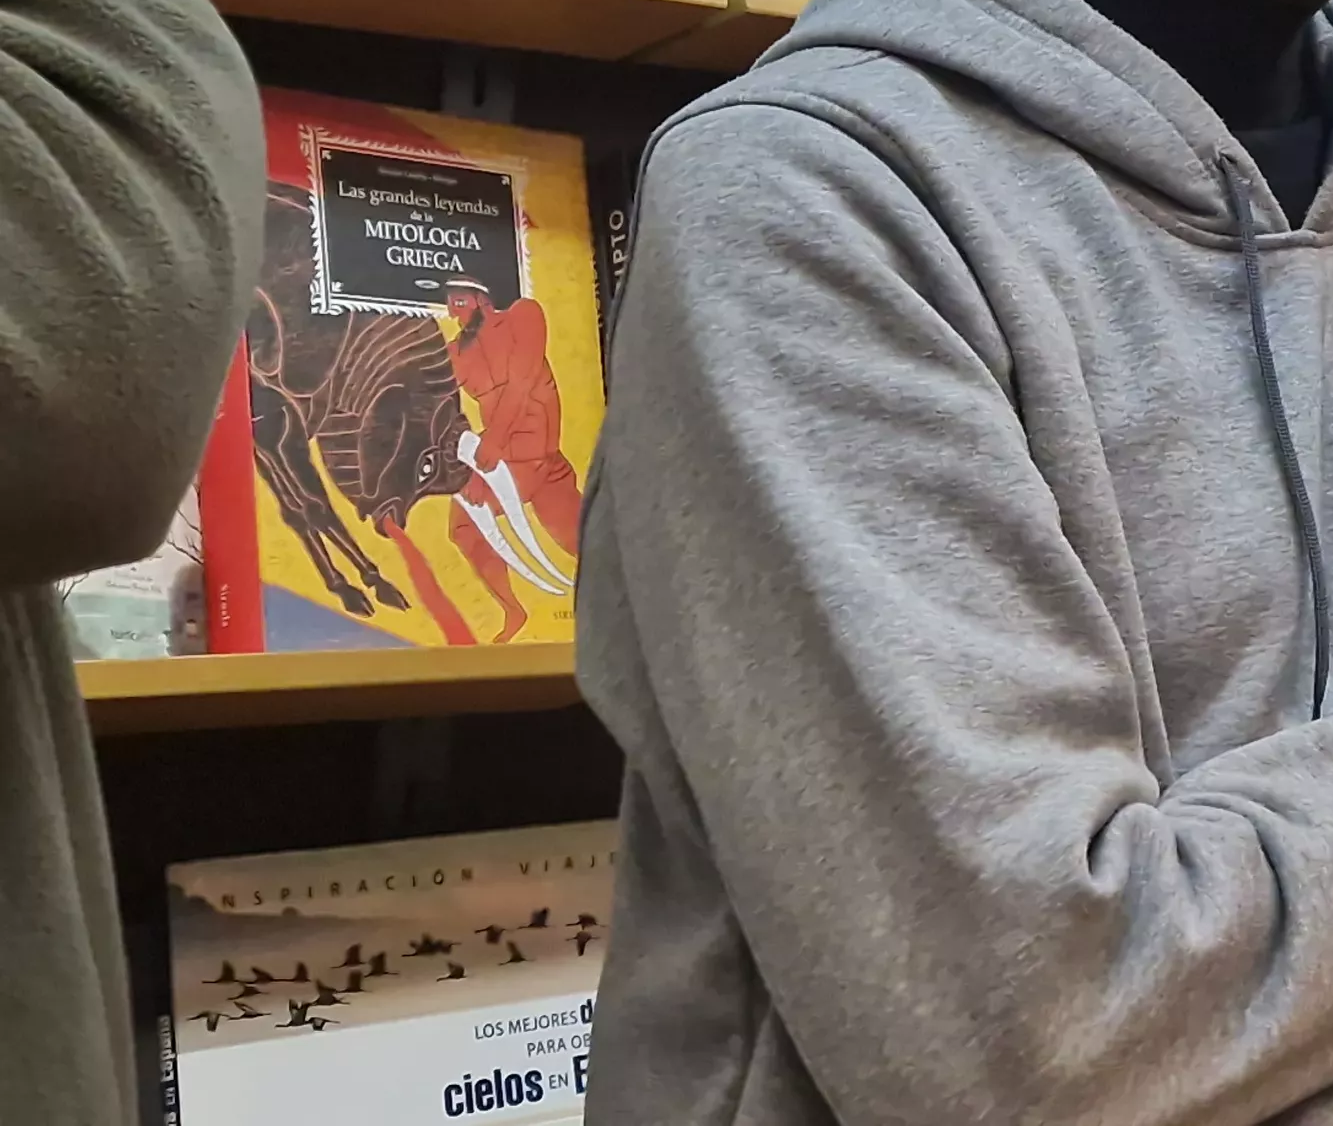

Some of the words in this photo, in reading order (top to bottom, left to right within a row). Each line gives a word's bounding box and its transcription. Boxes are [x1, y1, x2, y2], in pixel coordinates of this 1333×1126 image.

[338, 180, 366, 199] Las
[370, 189, 431, 206] grandes
[434, 193, 499, 216] leyendas
[410, 210, 423, 221] de
[424, 212, 434, 223] la
[364, 219, 481, 250] MITOLOGÍA
[608, 210, 629, 281] IPTO
[386, 245, 465, 272] GRIEGA
[221, 866, 475, 908] NSPIRACIÓN
[474, 1022, 505, 1041] LOS
[507, 1010, 578, 1036] MEJORES
[526, 1039, 567, 1057] PARA
[444, 1068, 544, 1118] cielos
[549, 1072, 569, 1090] EN
